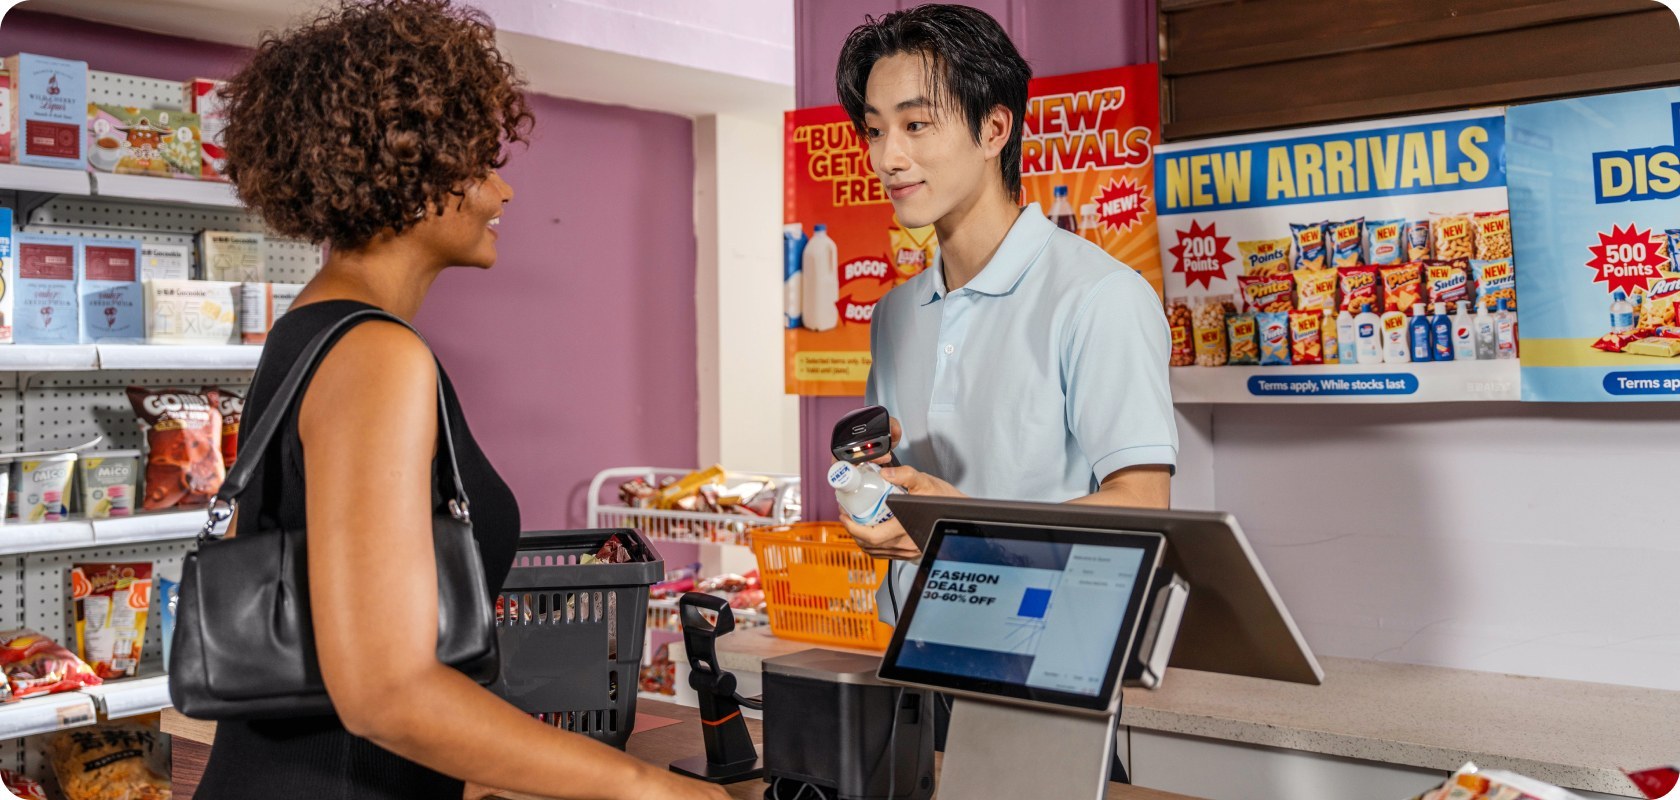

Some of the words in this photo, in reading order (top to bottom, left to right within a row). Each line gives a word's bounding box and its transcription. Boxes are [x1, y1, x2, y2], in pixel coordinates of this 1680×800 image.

[1020, 126, 1152, 177] RIVALS
[808, 150, 863, 181] GET
[1165, 150, 1252, 209] NEW
[1266, 126, 1490, 200] ARRIVALS
[833, 175, 892, 207] FRE
[1102, 194, 1138, 217] NEW!
[1337, 226, 1356, 240] NEW
[1377, 226, 1397, 240] NEW
[1443, 223, 1463, 238] NEW
[1483, 219, 1504, 233] NEW
[1300, 230, 1319, 242] NEW
[1182, 236, 1216, 257] 200
[1257, 243, 1274, 253] NEW
[1606, 243, 1647, 263] 500
[1184, 258, 1220, 272] Points
[1248, 250, 1284, 267] Points
[845, 260, 888, 280] BOGOF
[1430, 268, 1449, 278] NEW
[1484, 263, 1506, 278] NEW
[1603, 263, 1654, 277] Points
[1316, 281, 1334, 293] NEW
[845, 303, 874, 320] BOG
[1234, 323, 1253, 336] NEW
[1298, 318, 1316, 332] NEW
[1384, 316, 1403, 330] NEW
[1258, 380, 1288, 391] Terms
[1290, 381, 1319, 393] apply,
[1321, 380, 1349, 390] While
[1352, 379, 1384, 390] stocks
[1386, 379, 1405, 390] last
[1617, 377, 1660, 389] Terms
[931, 569, 1000, 585] FASHION
[927, 580, 977, 593] DEALS
[923, 591, 966, 603] 30-60%
[969, 596, 997, 606] OFF
